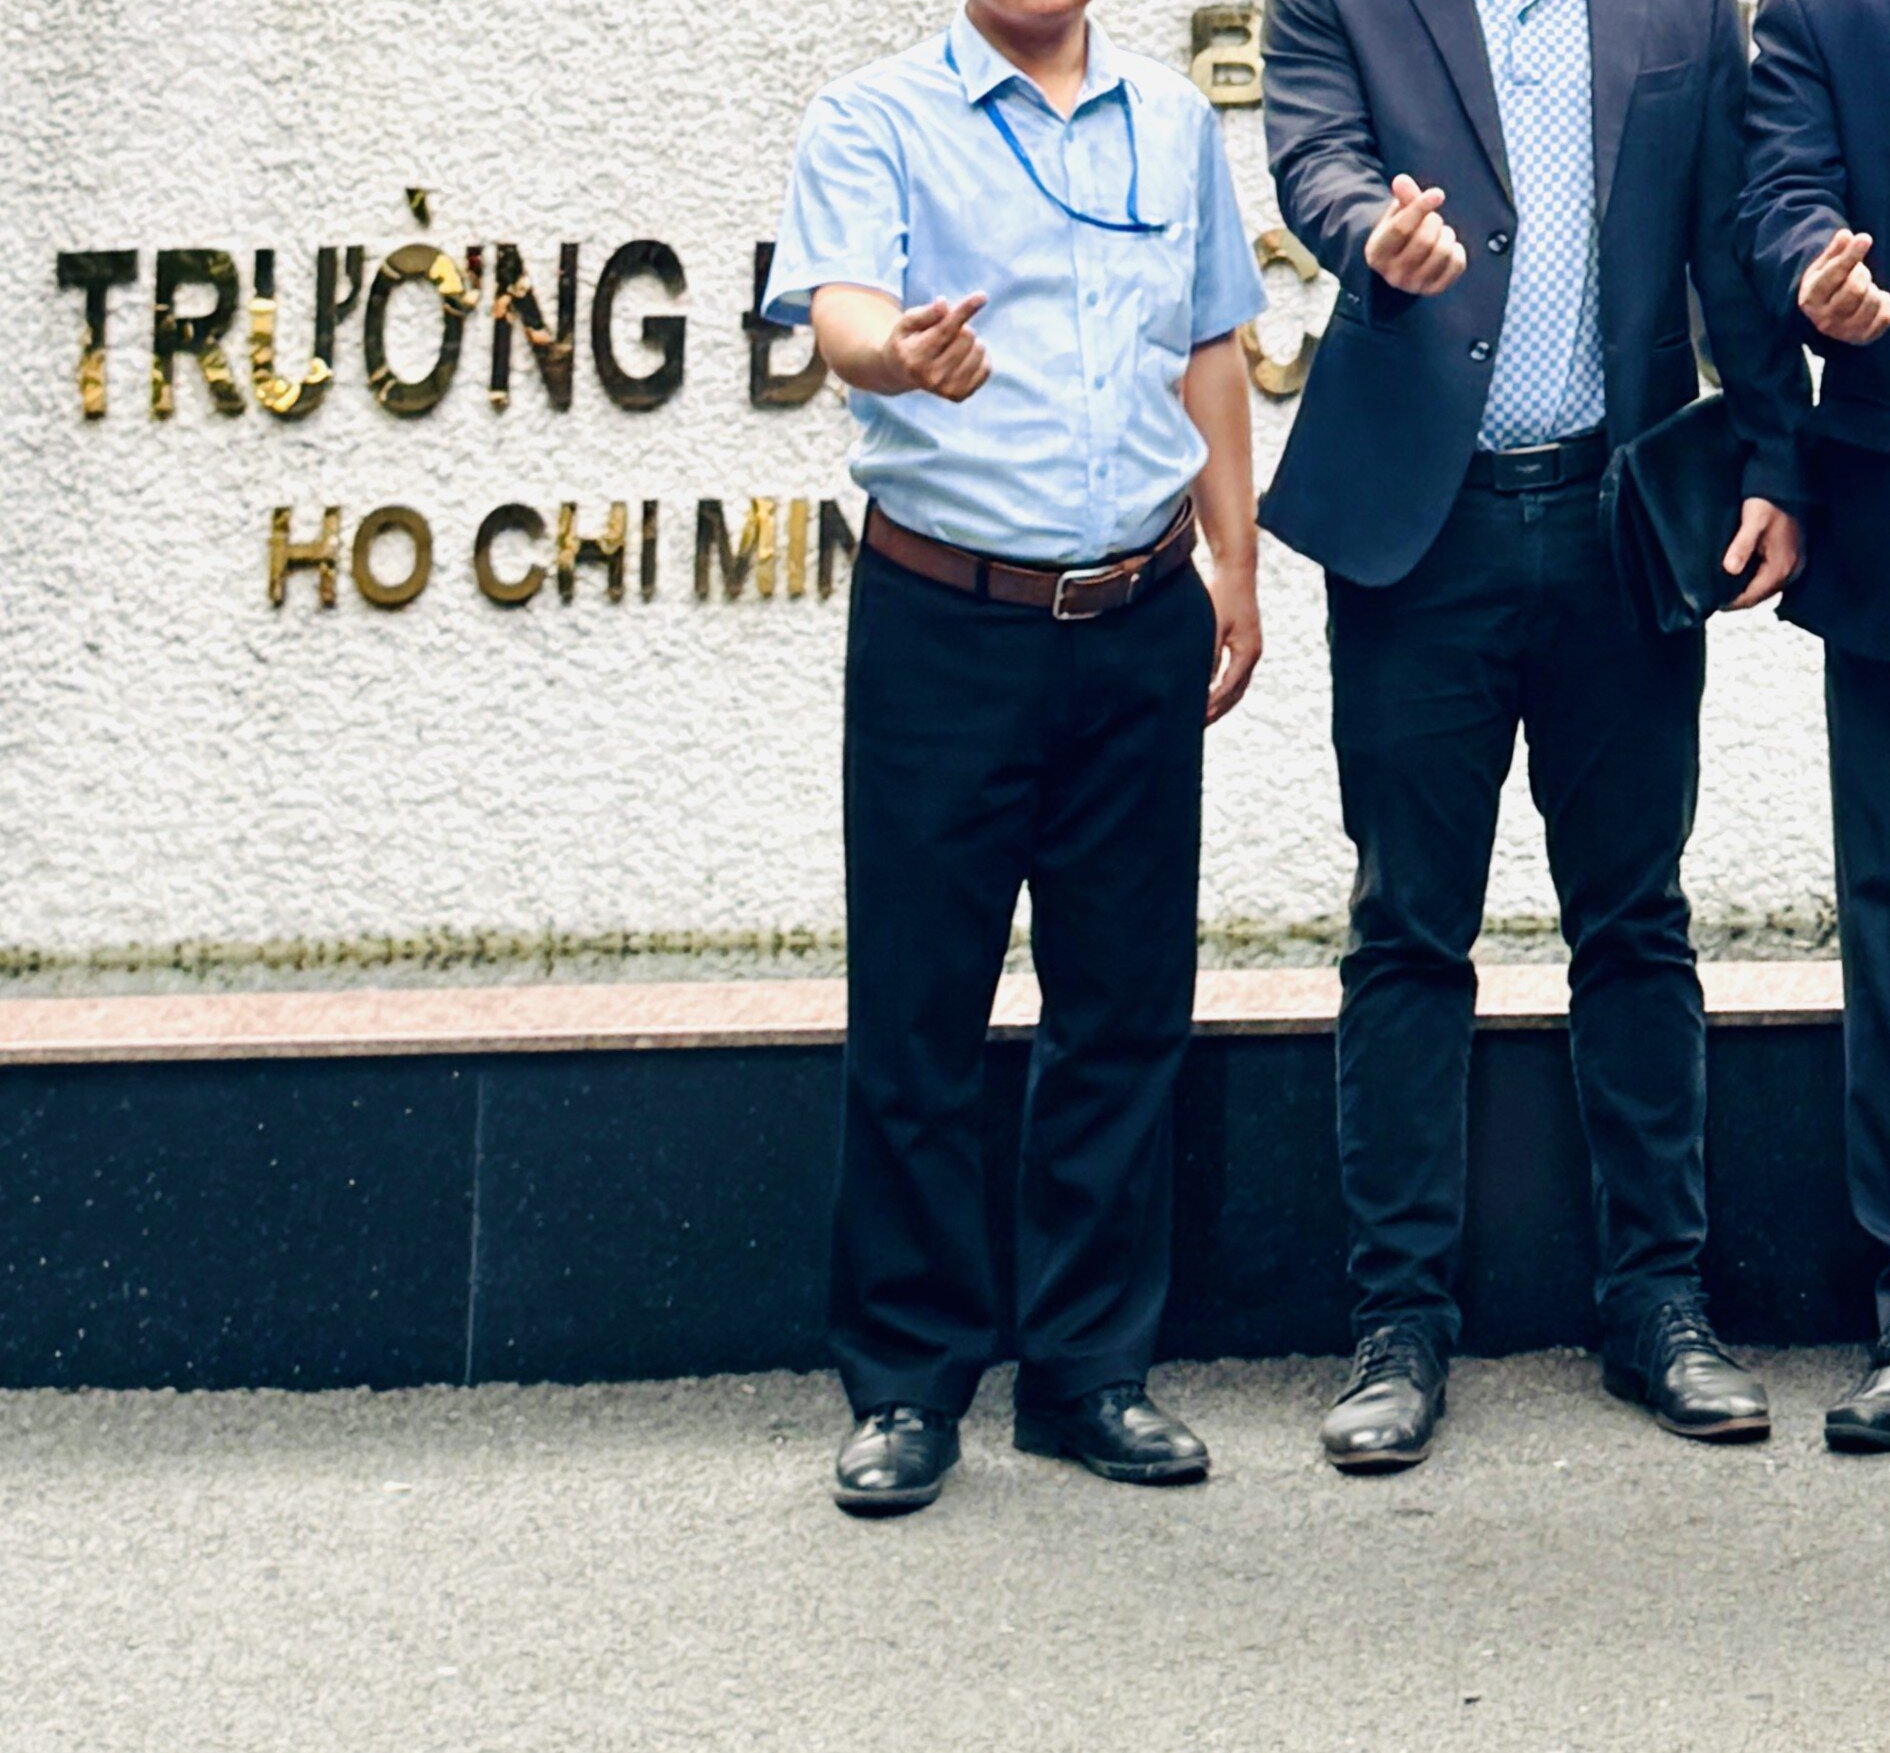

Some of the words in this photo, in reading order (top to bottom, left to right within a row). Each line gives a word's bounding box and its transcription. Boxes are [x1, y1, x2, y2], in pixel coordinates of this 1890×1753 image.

[56, 187, 688, 420] TRƯỜNG
[267, 504, 434, 610] HO
[473, 498, 661, 604] CHI
[694, 496, 857, 600] MIN
